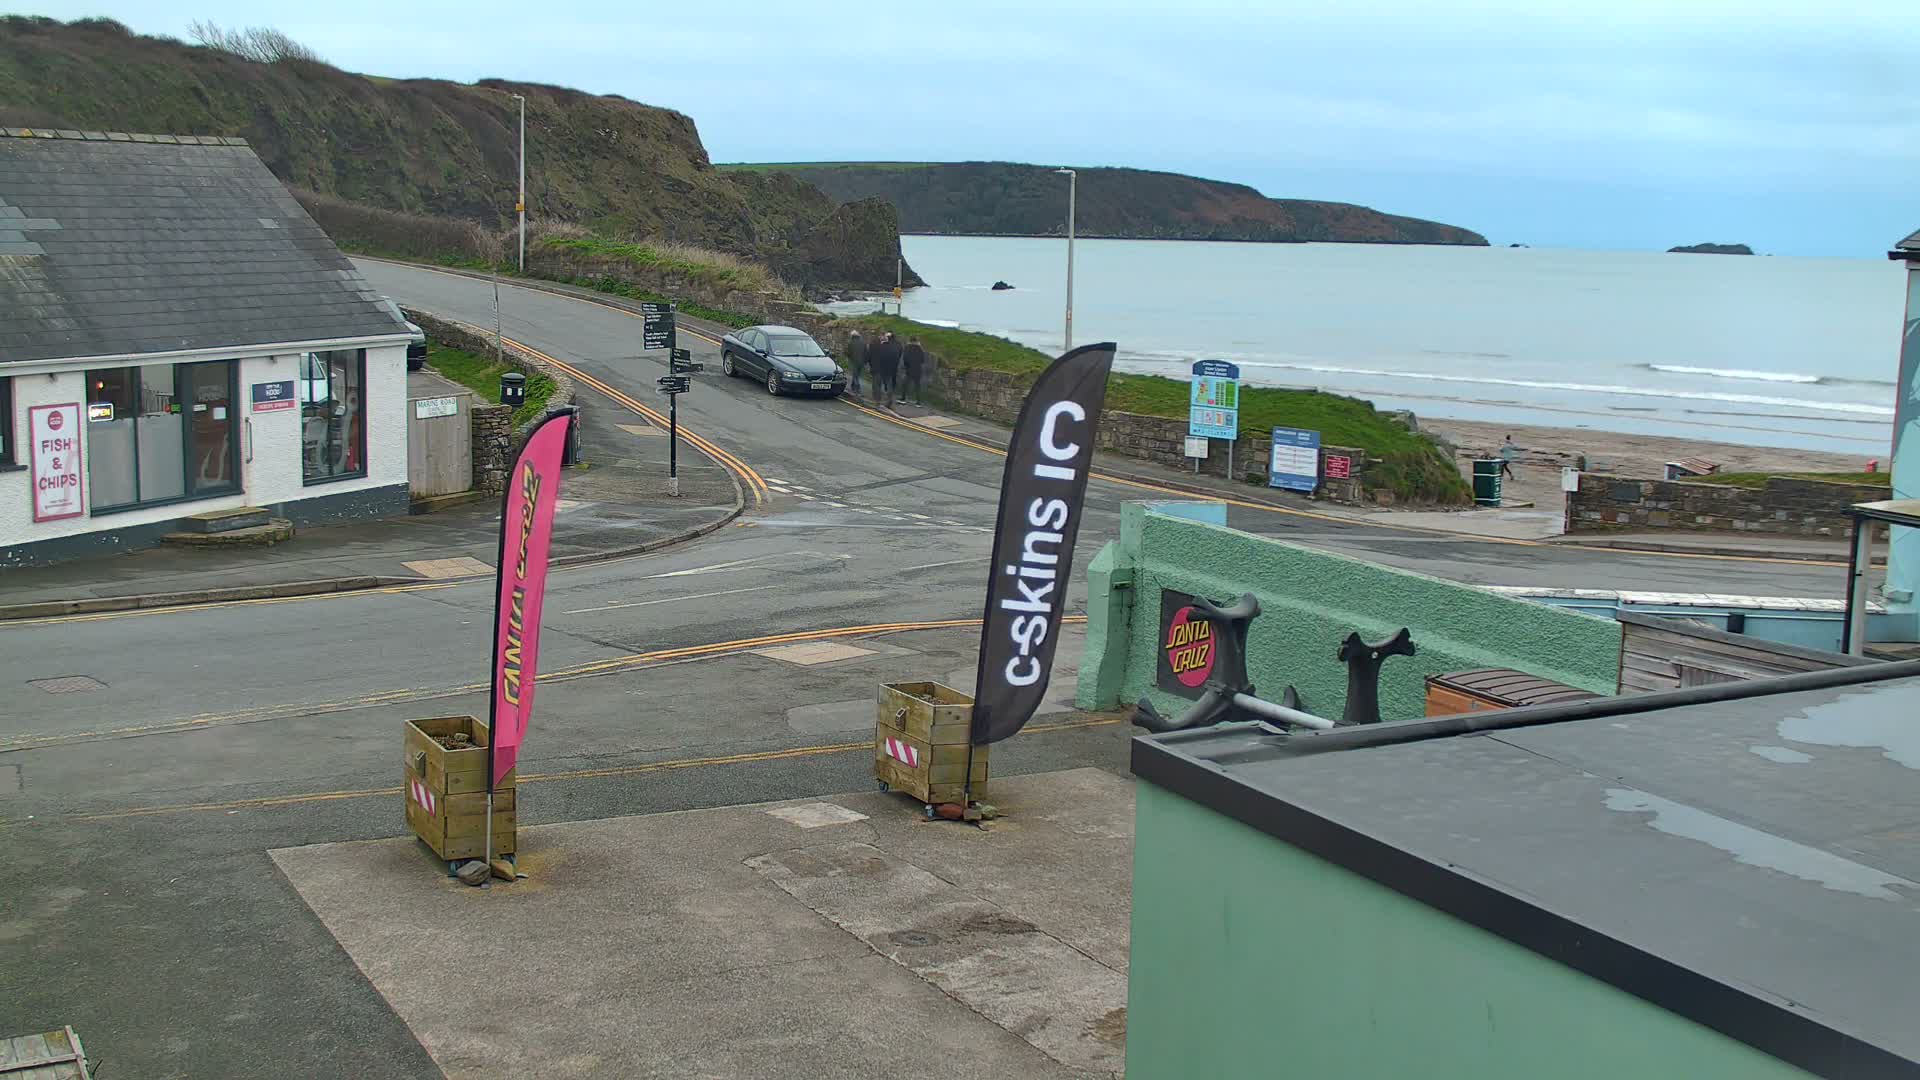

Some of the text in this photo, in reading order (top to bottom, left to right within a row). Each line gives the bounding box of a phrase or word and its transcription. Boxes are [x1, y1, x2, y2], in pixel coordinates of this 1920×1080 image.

[417, 397, 456, 407] MARINE ROAD
[41, 437, 72, 454] FISH
[52, 457, 63, 470] &
[38, 473, 78, 490] CHIPS
[1166, 620, 1211, 649] SANTA
[1173, 644, 1209, 673] CRUZ
